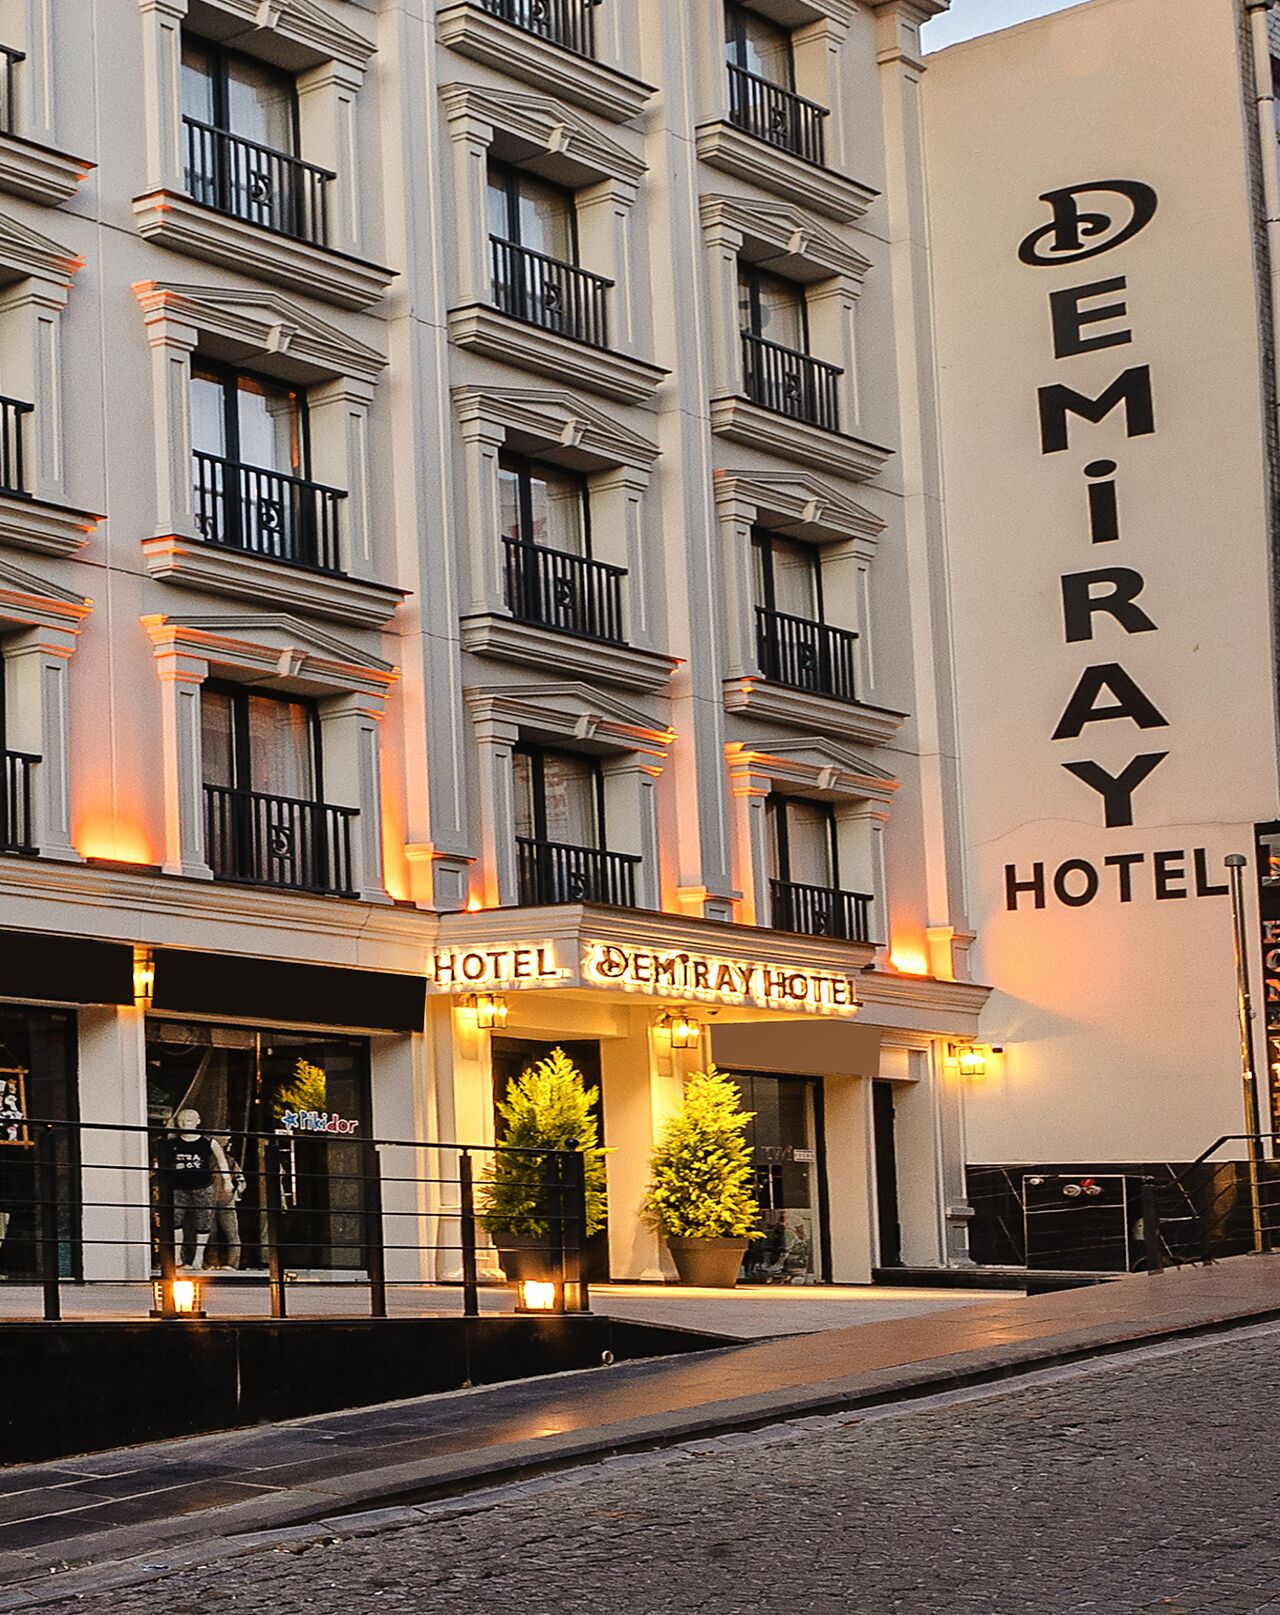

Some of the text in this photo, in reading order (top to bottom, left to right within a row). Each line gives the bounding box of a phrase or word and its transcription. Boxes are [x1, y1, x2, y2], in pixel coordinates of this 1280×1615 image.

[1004, 847, 1229, 911] HOTEL
[433, 947, 559, 985] HOTEL
[764, 971, 865, 1008] HOTEL
